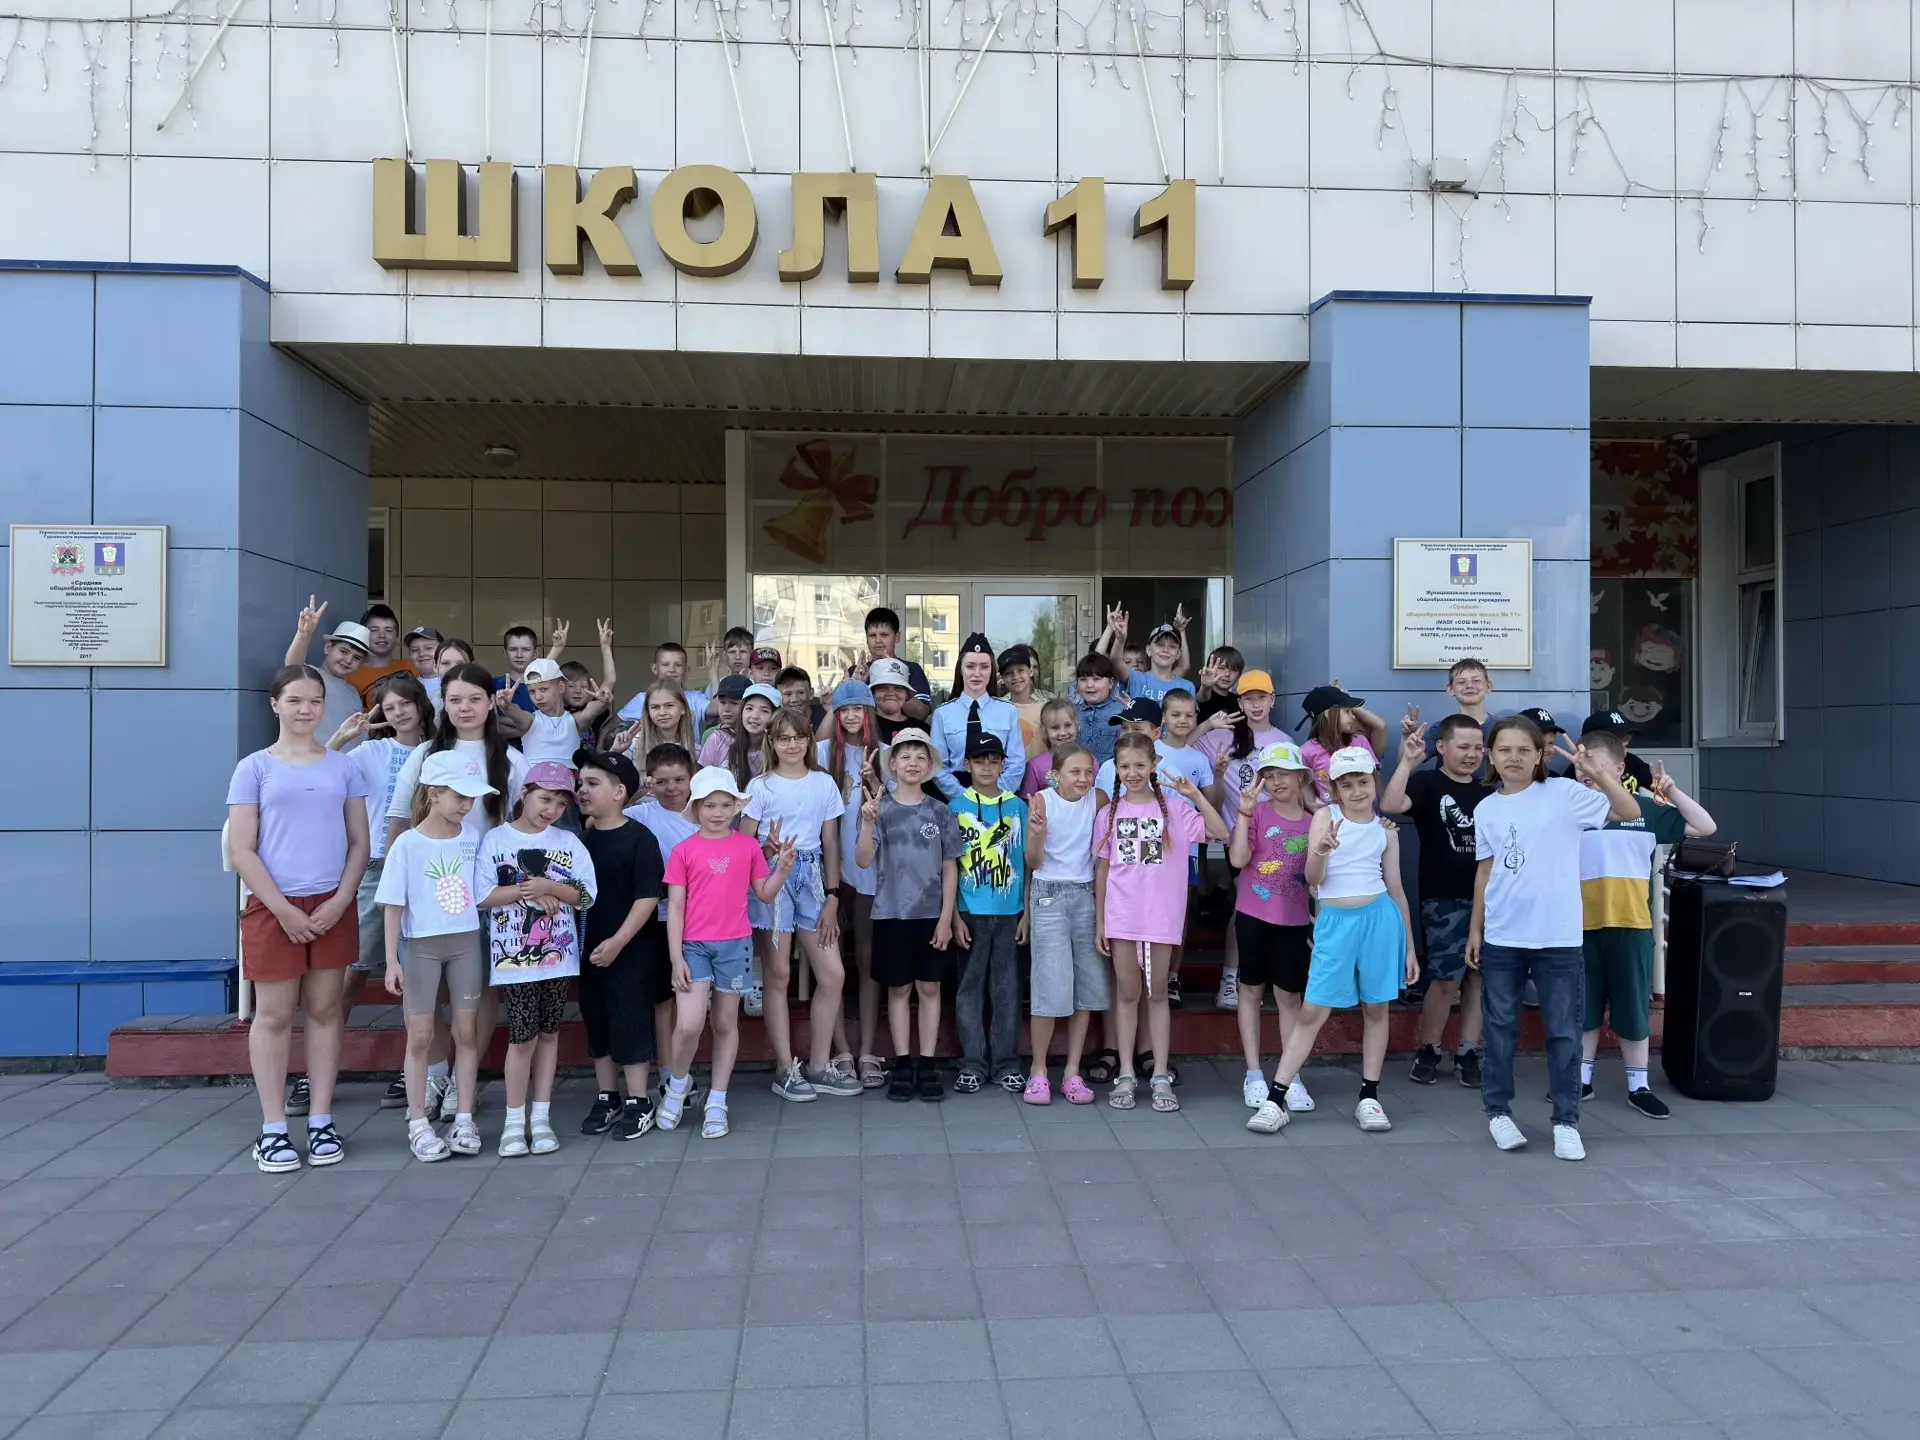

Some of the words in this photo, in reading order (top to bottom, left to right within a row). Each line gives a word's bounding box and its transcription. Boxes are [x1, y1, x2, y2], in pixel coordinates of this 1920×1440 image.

[372, 158, 1004, 287] ШКОЛА
[1043, 177, 1197, 290] 11
[903, 465, 1105, 542] Добро
[544, 849, 573, 869] DISCO
